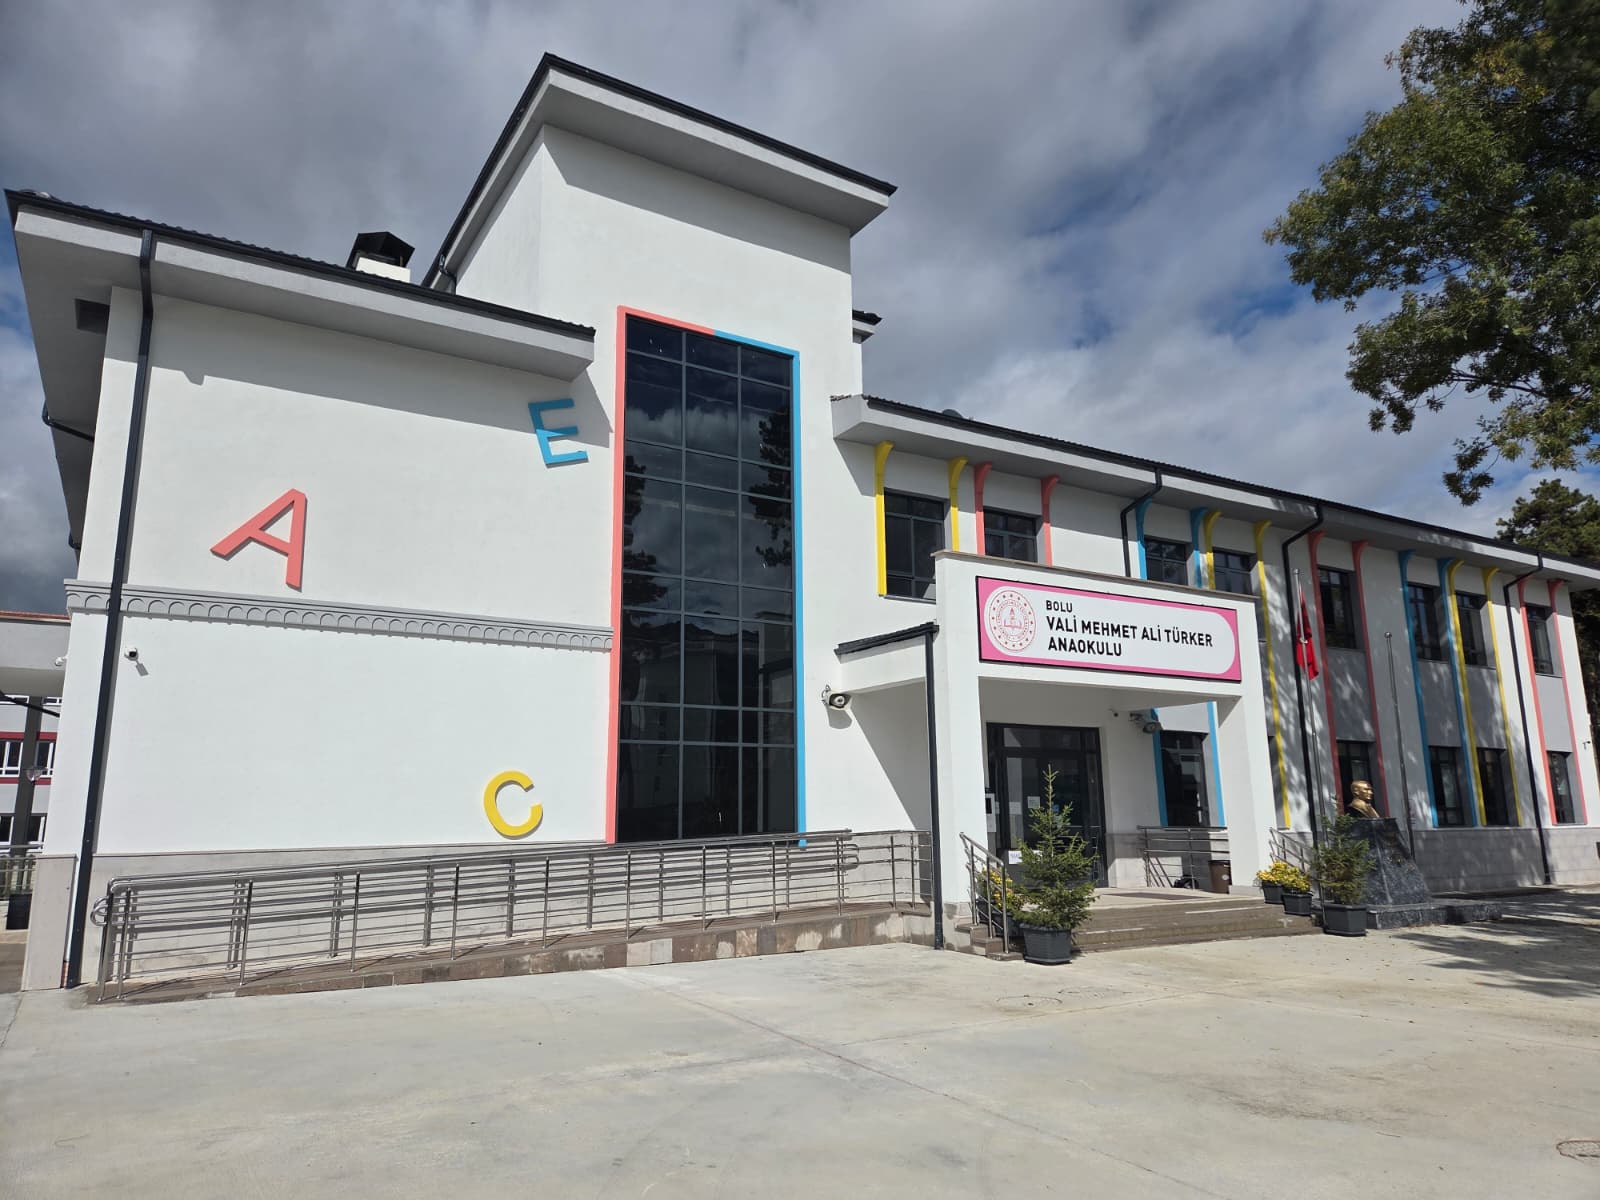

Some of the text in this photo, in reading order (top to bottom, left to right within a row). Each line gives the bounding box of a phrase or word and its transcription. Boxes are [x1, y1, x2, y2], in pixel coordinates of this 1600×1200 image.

[528, 398, 588, 467] E
[210, 488, 307, 592] A
[1046, 600, 1073, 613] BOLU
[1046, 615, 1077, 633] VALİ
[1081, 620, 1138, 639] MEHMET
[1141, 625, 1162, 642] ALİ
[1164, 626, 1213, 647] TÜRKER
[1048, 636, 1122, 657] ANAOKULU
[483, 770, 543, 838] C
